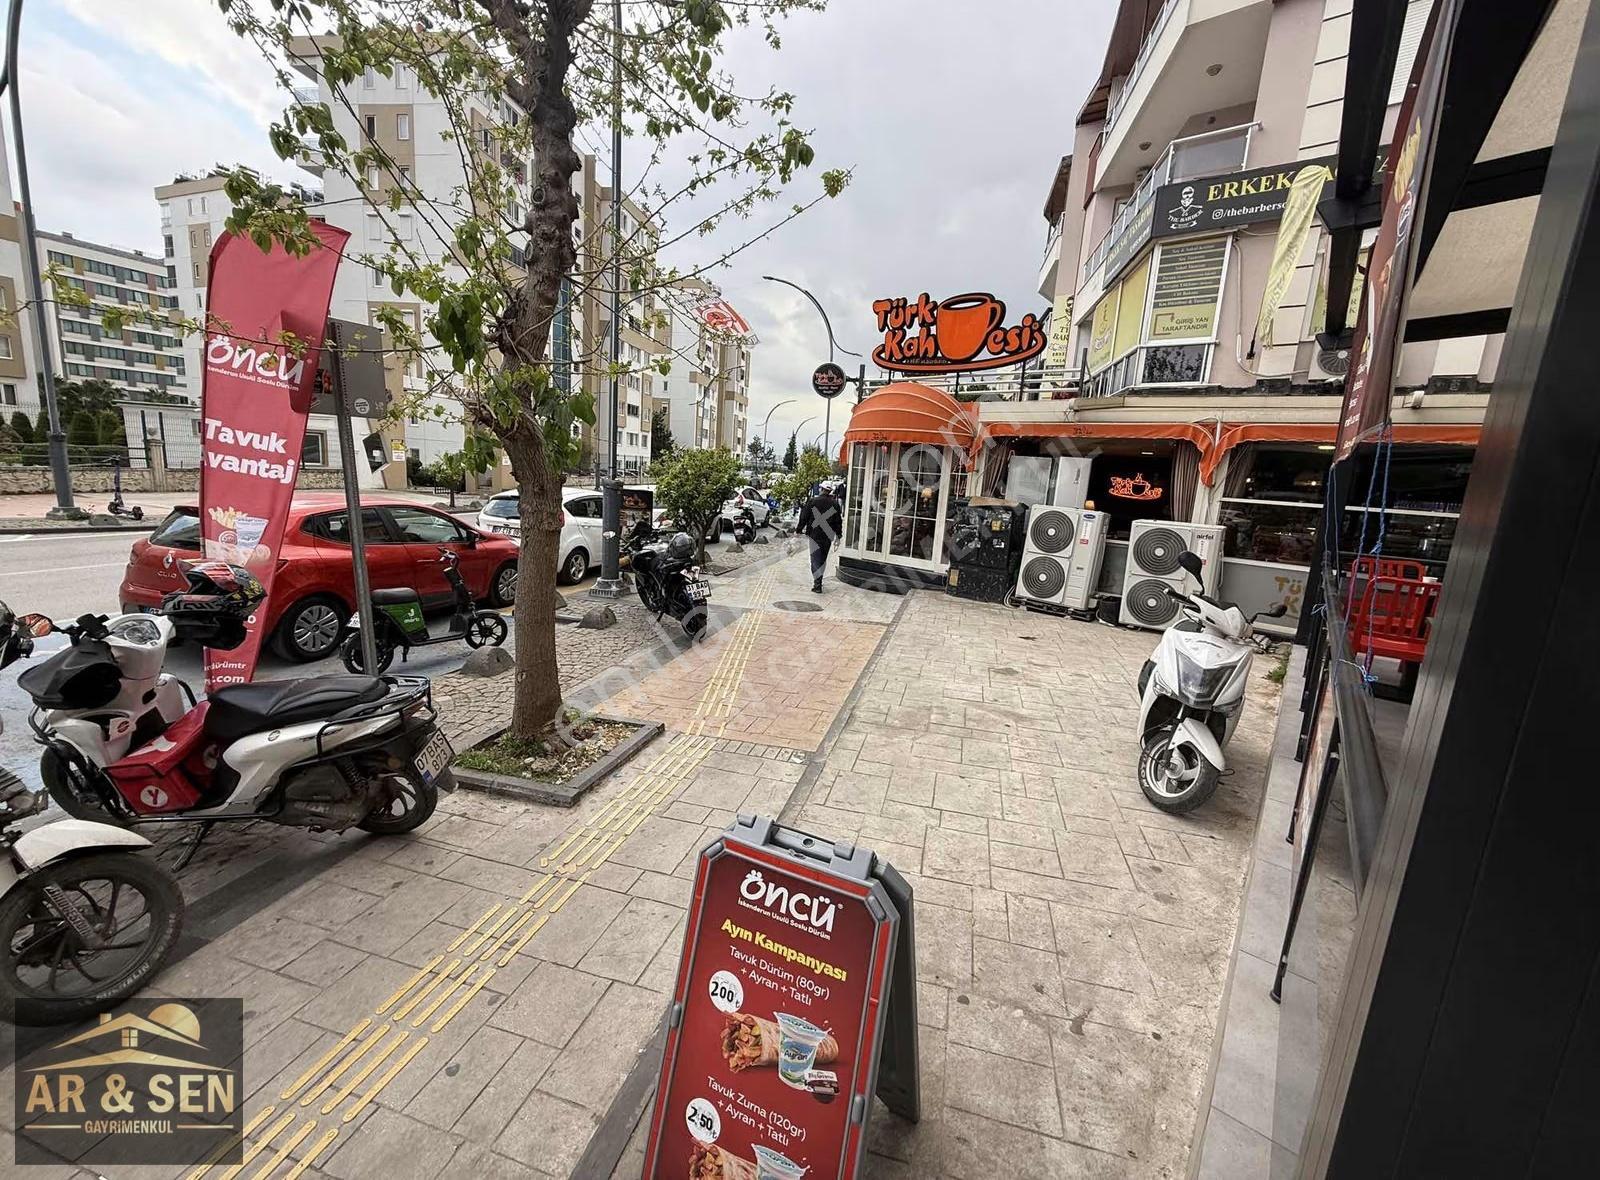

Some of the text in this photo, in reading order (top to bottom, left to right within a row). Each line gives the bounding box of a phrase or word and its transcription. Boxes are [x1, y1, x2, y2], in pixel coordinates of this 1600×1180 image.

[1207, 171, 1297, 201] ERKEK
[873, 292, 938, 332] Türk
[1162, 324, 1208, 332] TARAFTANDIR
[204, 417, 288, 454] Tavuk
[204, 450, 296, 485] vantaj
[431, 749, 448, 771] 873
[772, 911, 789, 924] Usulü
[790, 919, 808, 933] Soslu
[808, 925, 830, 940] Dürüm
[721, 919, 847, 981] Ayın Kampanyası
[730, 946, 830, 1000] Tavuk Dürüm (80gr)
[748, 970, 778, 991] Ayran
[790, 987, 811, 1006] Tatlı
[711, 981, 734, 1002] 200
[784, 1049, 807, 1060] Ayran
[708, 1076, 807, 1141] Tavuk Zurna (120gr)
[725, 1105, 756, 1128] Ayran
[767, 1125, 789, 1146] Tatlı
